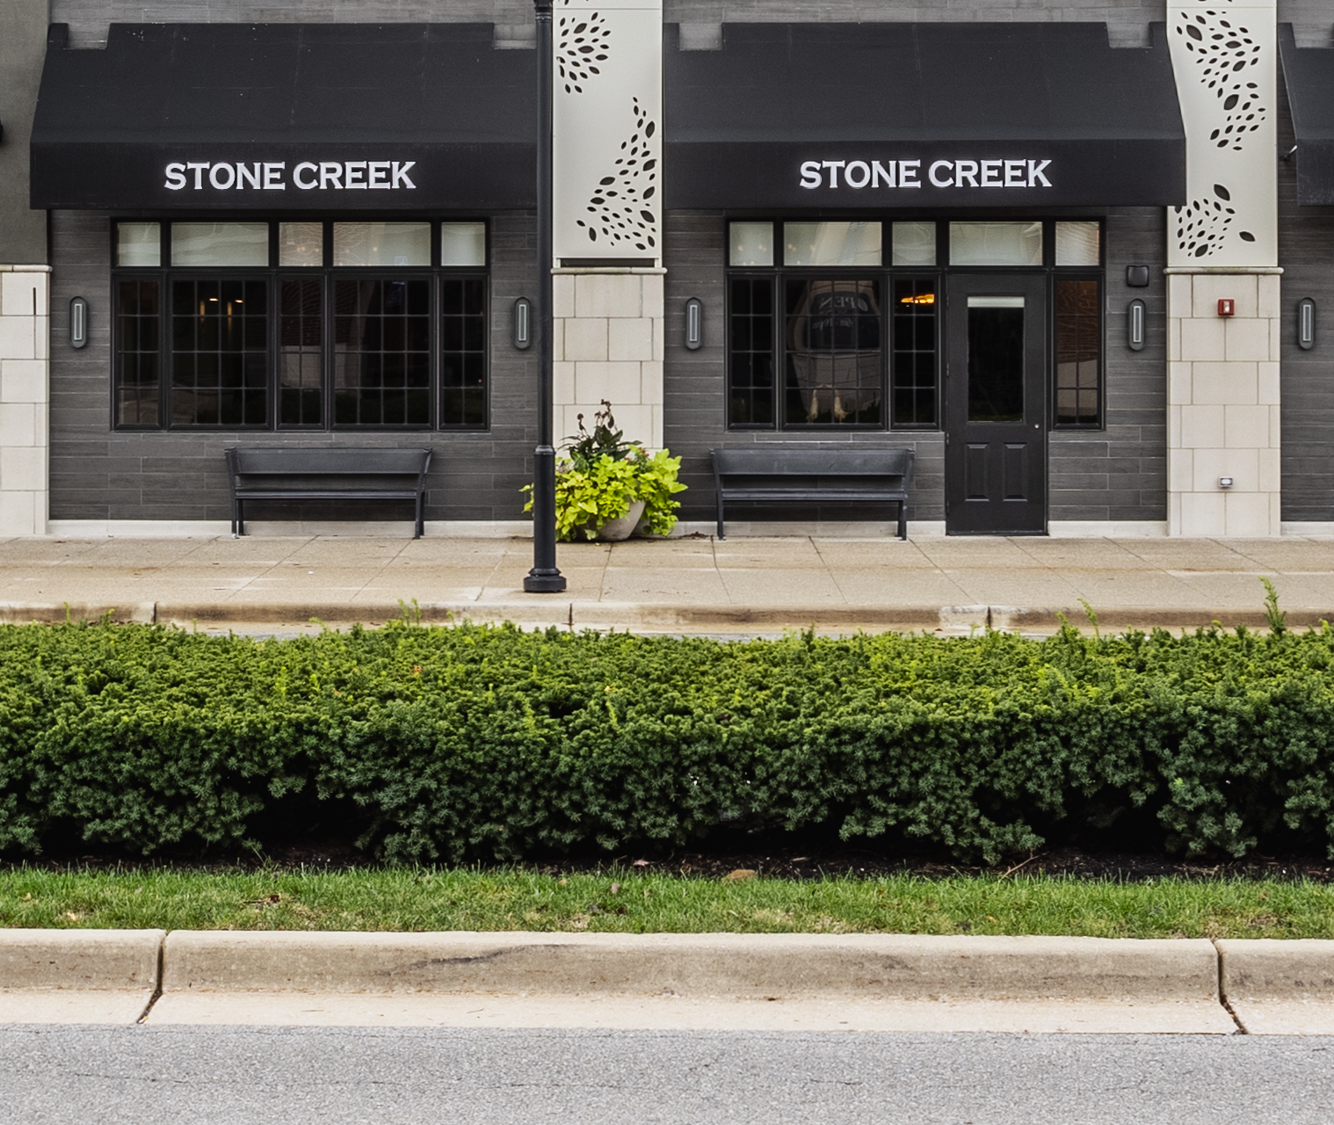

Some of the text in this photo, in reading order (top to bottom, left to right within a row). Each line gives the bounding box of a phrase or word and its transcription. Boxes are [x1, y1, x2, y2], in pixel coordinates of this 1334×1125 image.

[163, 160, 417, 191] STONE CREEK
[799, 158, 1053, 189] STONE CREEK
